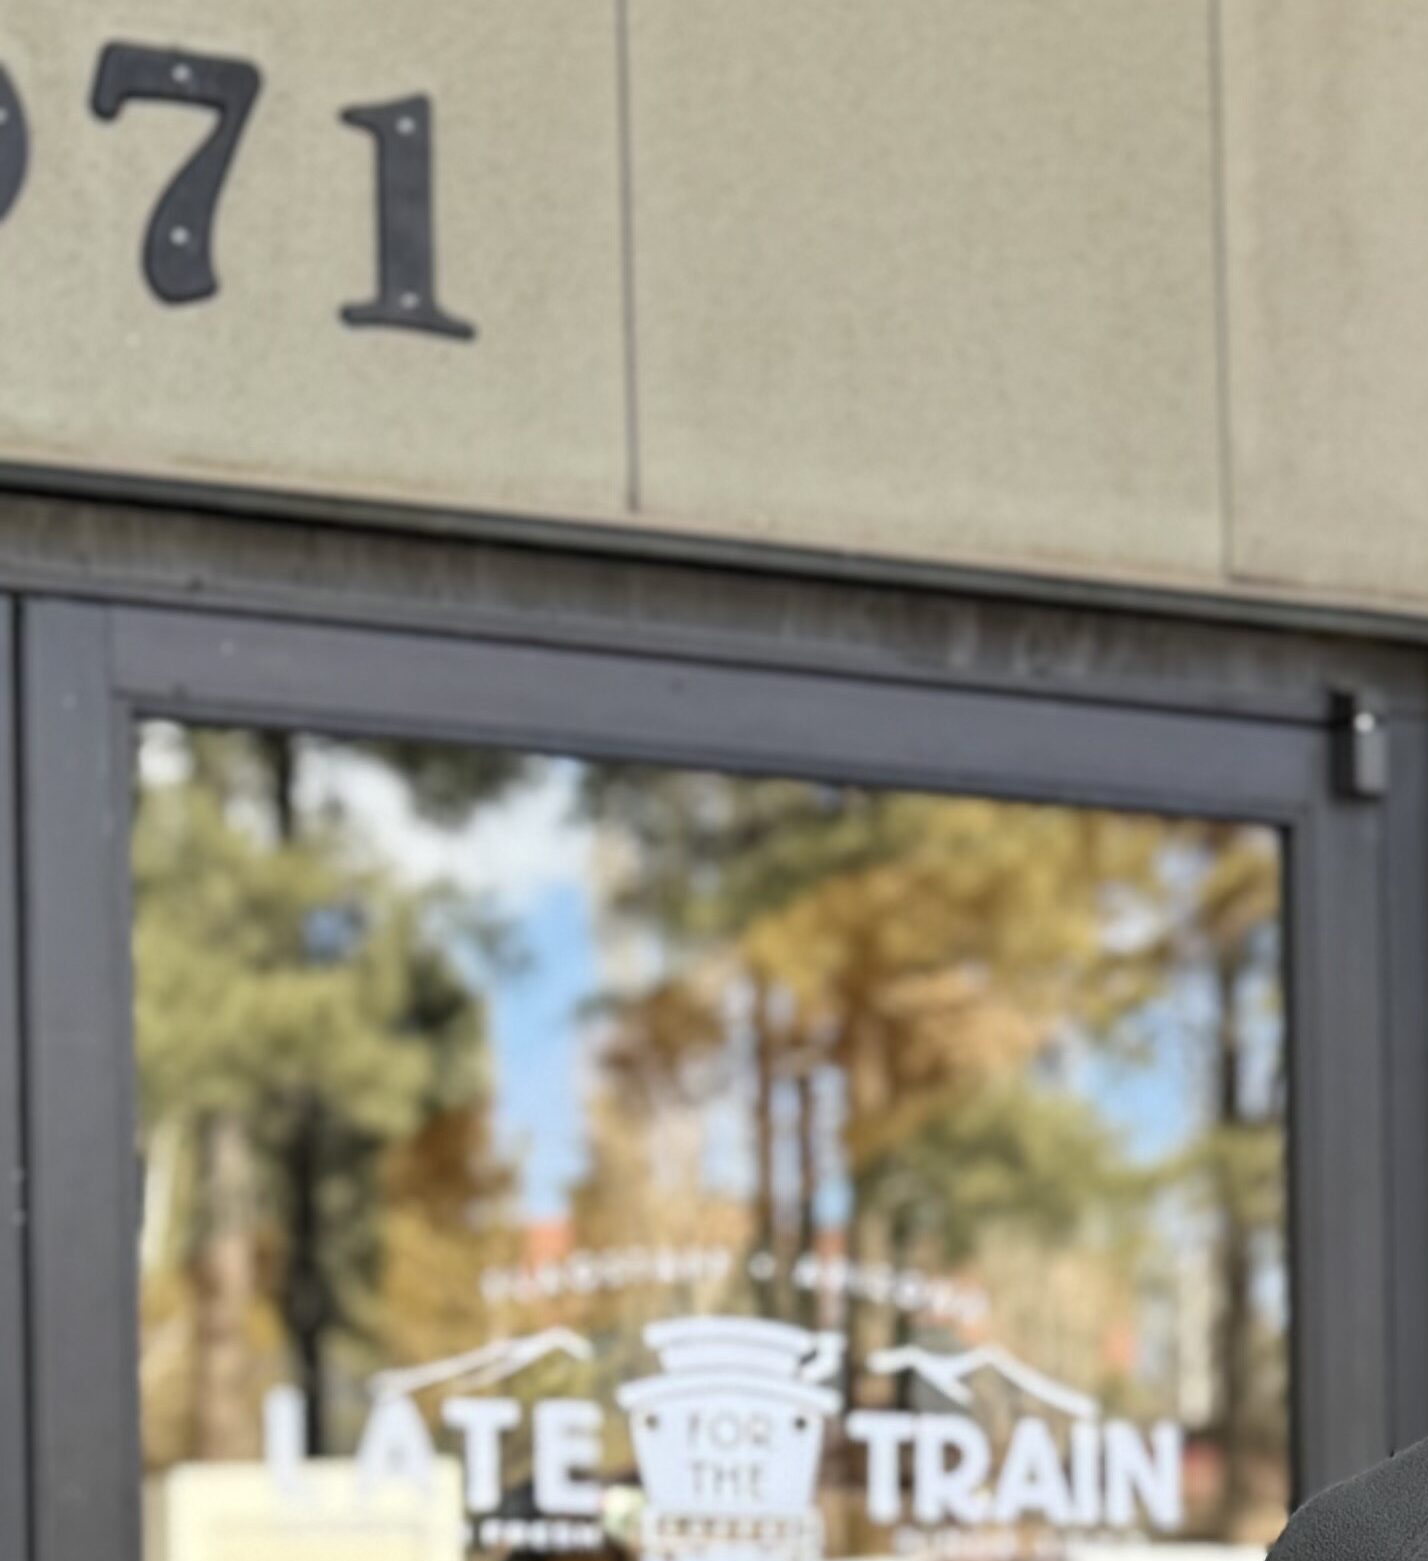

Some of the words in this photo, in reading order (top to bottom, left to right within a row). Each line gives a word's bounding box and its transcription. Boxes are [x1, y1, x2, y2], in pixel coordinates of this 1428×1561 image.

[0, 40, 478, 342] 71
[261, 1382, 605, 1514] LATE
[686, 1411, 775, 1453] FOR
[690, 1459, 764, 1502] THE
[844, 1410, 1184, 1530] TRAIN
